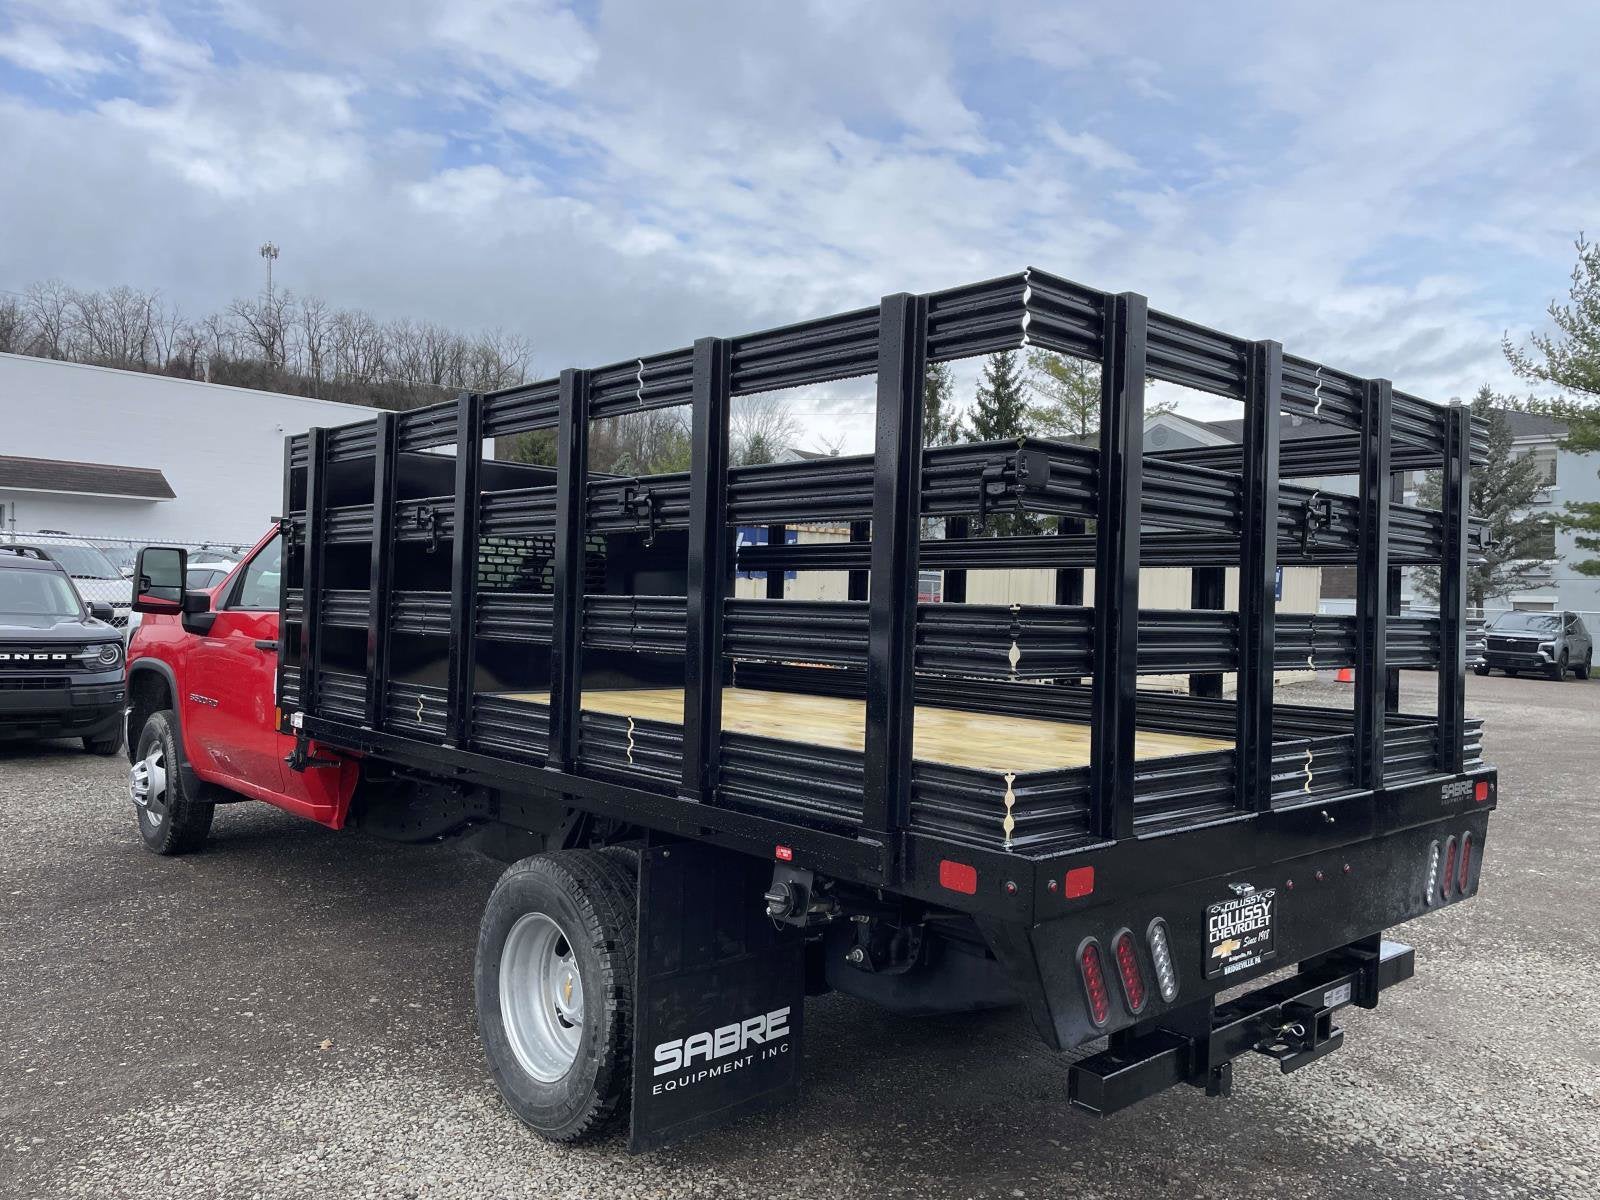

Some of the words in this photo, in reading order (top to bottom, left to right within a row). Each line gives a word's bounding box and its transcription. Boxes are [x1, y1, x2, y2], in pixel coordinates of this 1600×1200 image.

[1441, 779, 1474, 800] SABRE
[1224, 893, 1262, 912] COLUSSY
[1209, 901, 1272, 932] COLUSSY
[1209, 915, 1272, 943] CHEVROLET
[1243, 936, 1258, 947] Since
[1254, 956, 1262, 965] PA
[653, 1006, 791, 1077] SABRE
[652, 1055, 754, 1095] EQUIPMENT
[762, 1043, 790, 1061] INC
